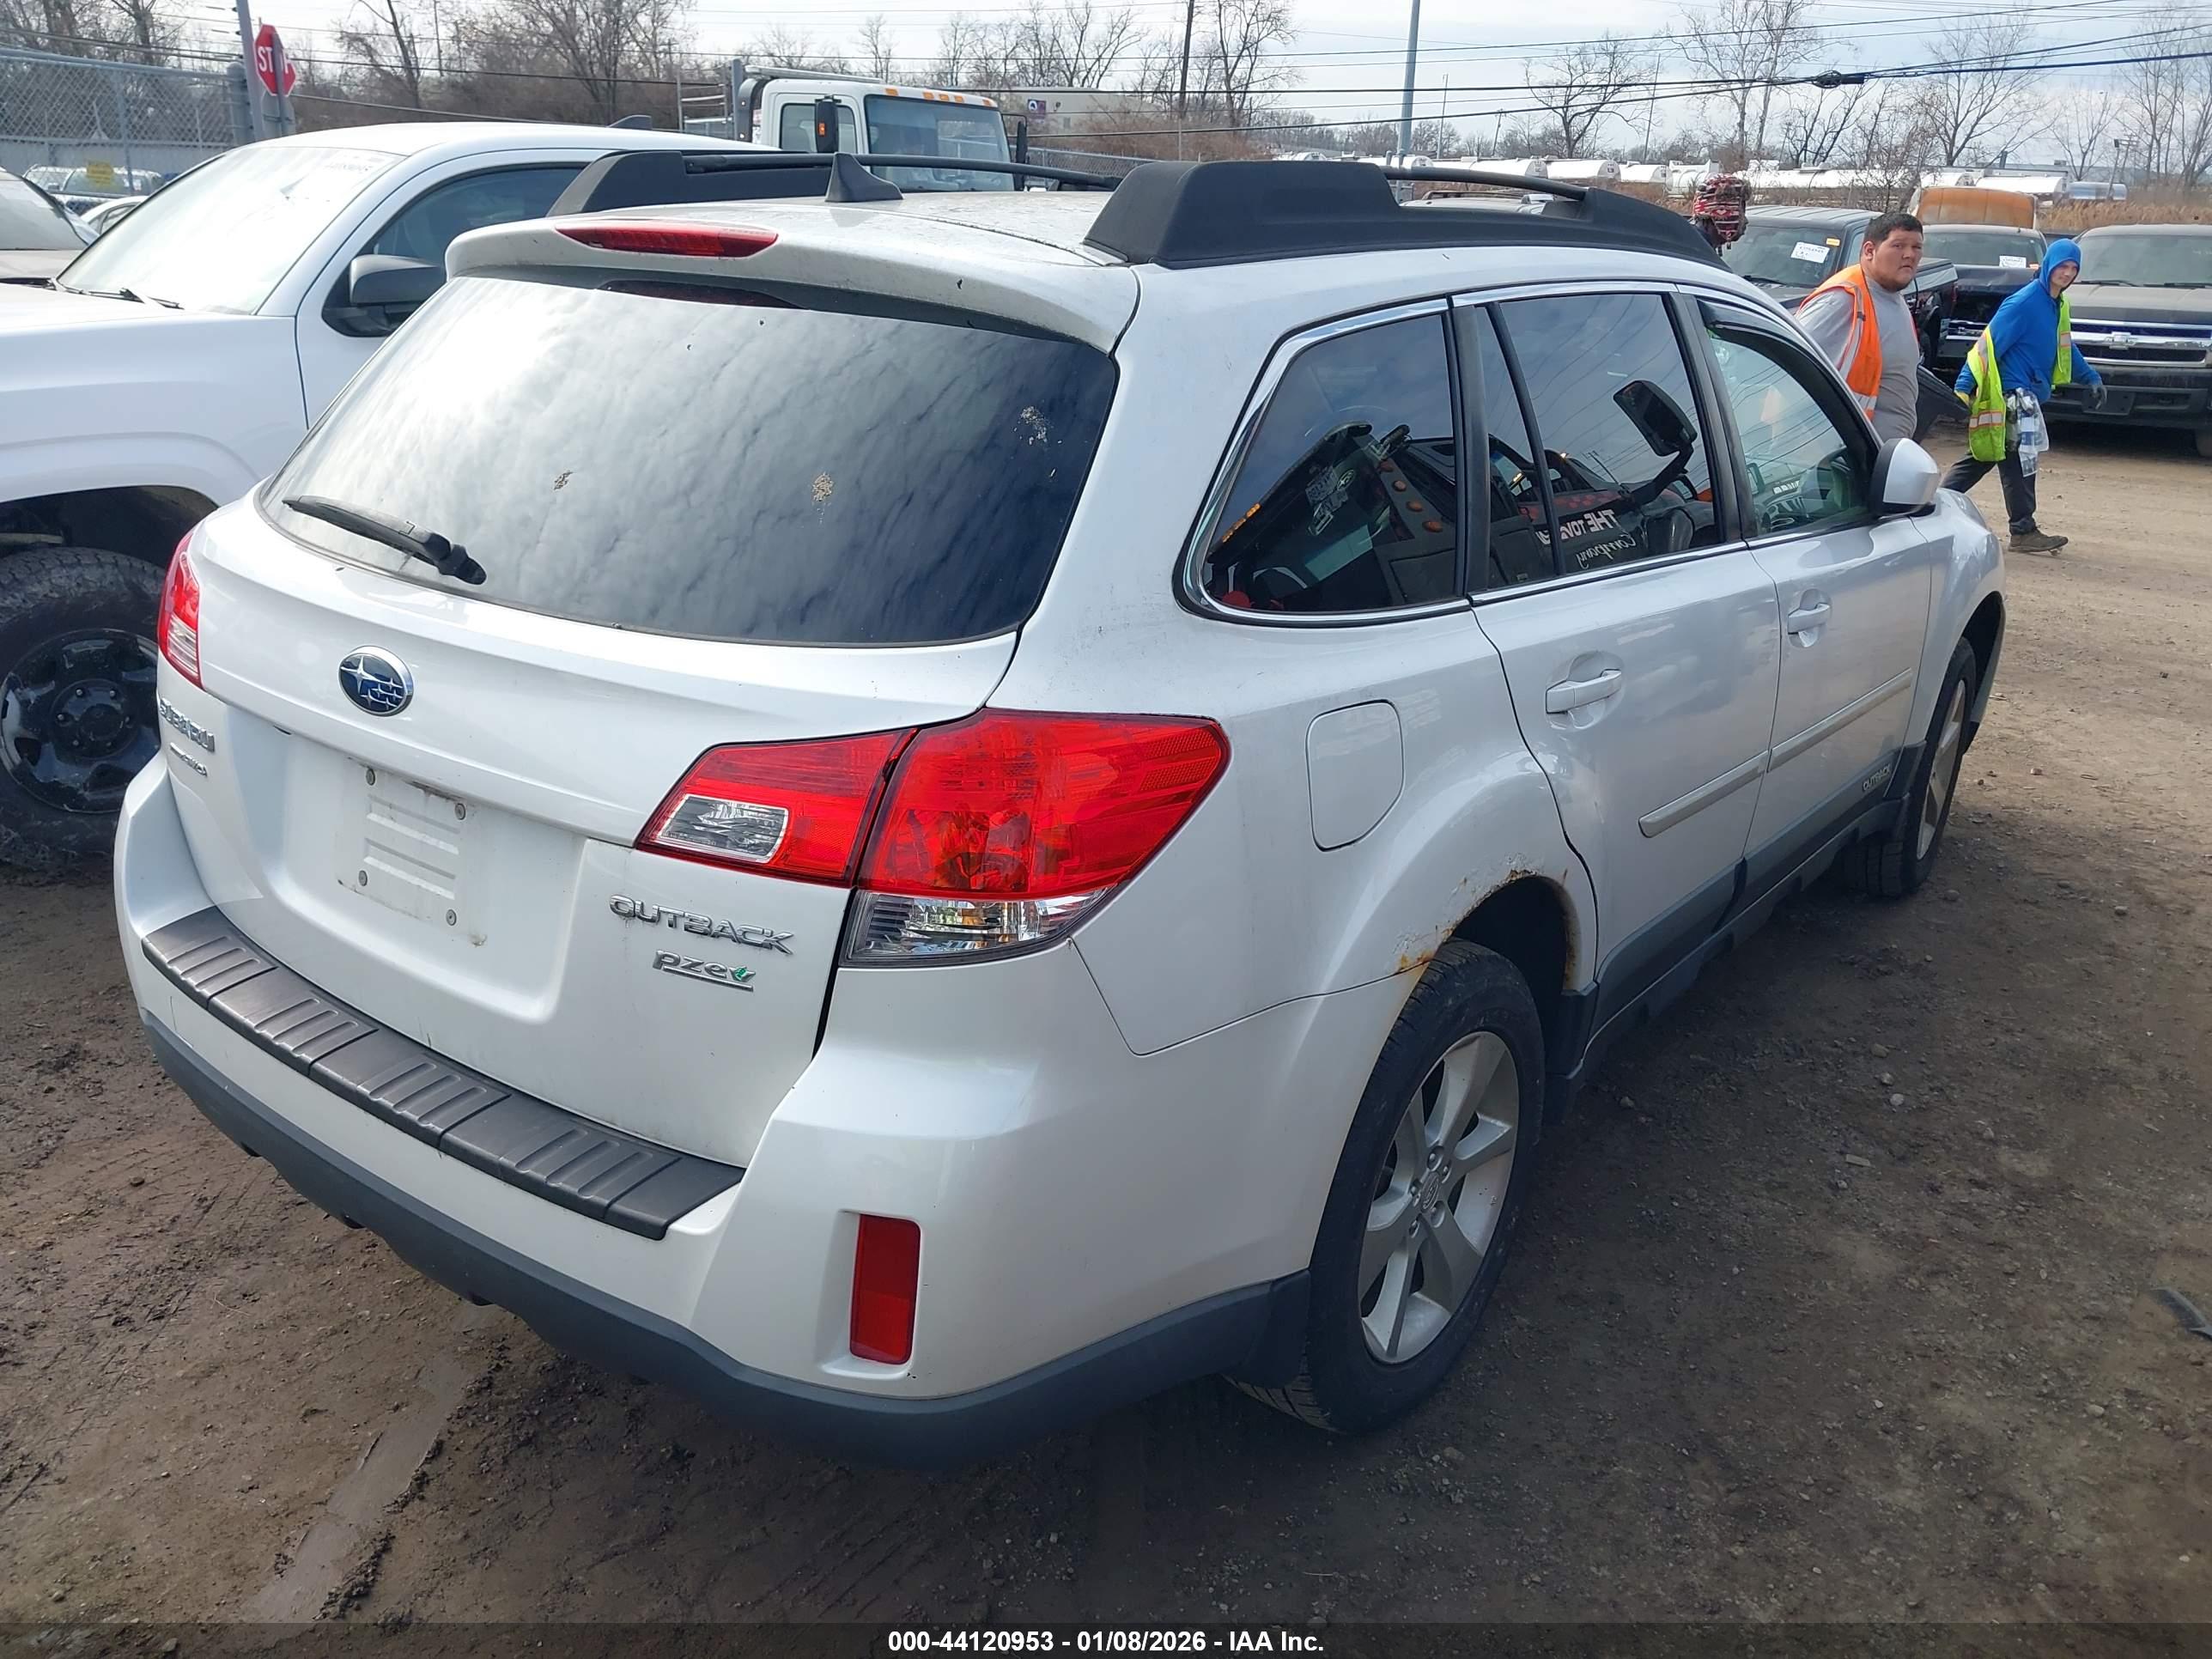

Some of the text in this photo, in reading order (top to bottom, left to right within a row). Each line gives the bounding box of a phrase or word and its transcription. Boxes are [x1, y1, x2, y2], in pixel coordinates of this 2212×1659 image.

[258, 46, 294, 74] STP
[160, 697, 216, 753] SUBARU
[610, 894, 794, 956] OUTBACK
